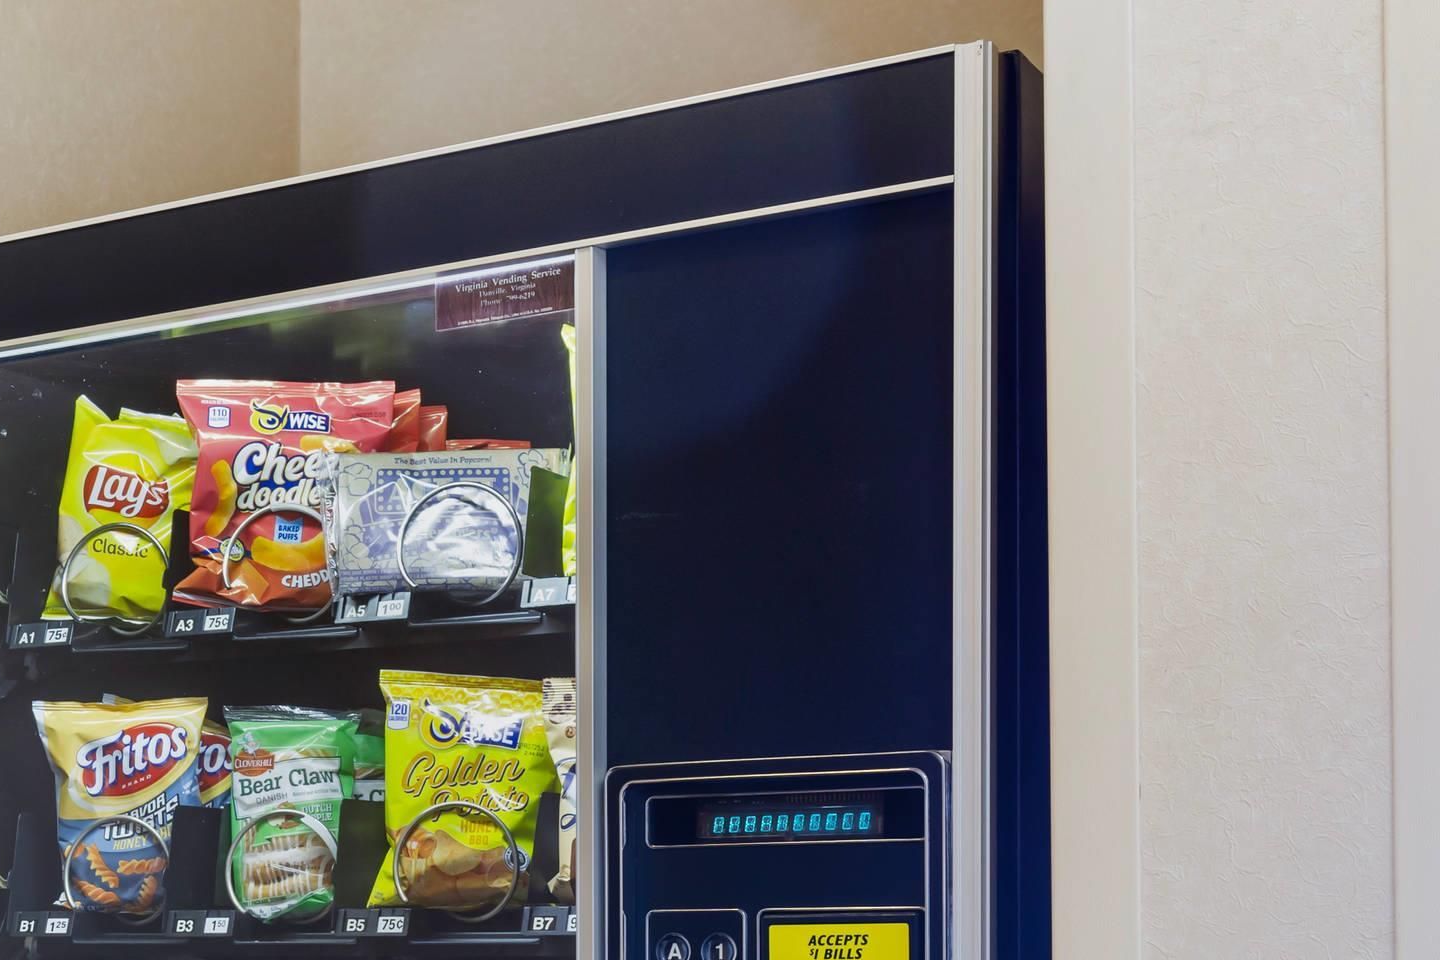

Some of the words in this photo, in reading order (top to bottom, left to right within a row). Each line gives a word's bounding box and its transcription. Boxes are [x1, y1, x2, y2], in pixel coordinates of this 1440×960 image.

[456, 281, 488, 293] Virginia
[492, 274, 527, 287] Vending
[531, 267, 561, 279] Service
[289, 413, 327, 431] WISE
[87, 466, 166, 518] Lay's
[237, 478, 321, 512] doodle
[278, 524, 300, 533] BAKED
[277, 532, 299, 541] PUFFS
[93, 538, 148, 558] Classic
[281, 568, 330, 589] CHEDD
[534, 587, 554, 602] A7
[346, 604, 366, 618] A5
[175, 619, 194, 632] A3
[19, 631, 35, 644] A1
[390, 703, 408, 716] 120
[75, 725, 188, 797] Fritos
[401, 751, 526, 797] Golden
[239, 775, 283, 797] Bear
[288, 768, 335, 787] Claw
[19, 919, 35, 932] B1
[176, 919, 194, 932] B3
[346, 918, 366, 932] B5
[532, 917, 554, 931] B7
[808, 934, 869, 946] ACCEPTS
[668, 943, 682, 960] A
[715, 943, 724, 960] 1
[823, 948, 862, 960] BILLS
